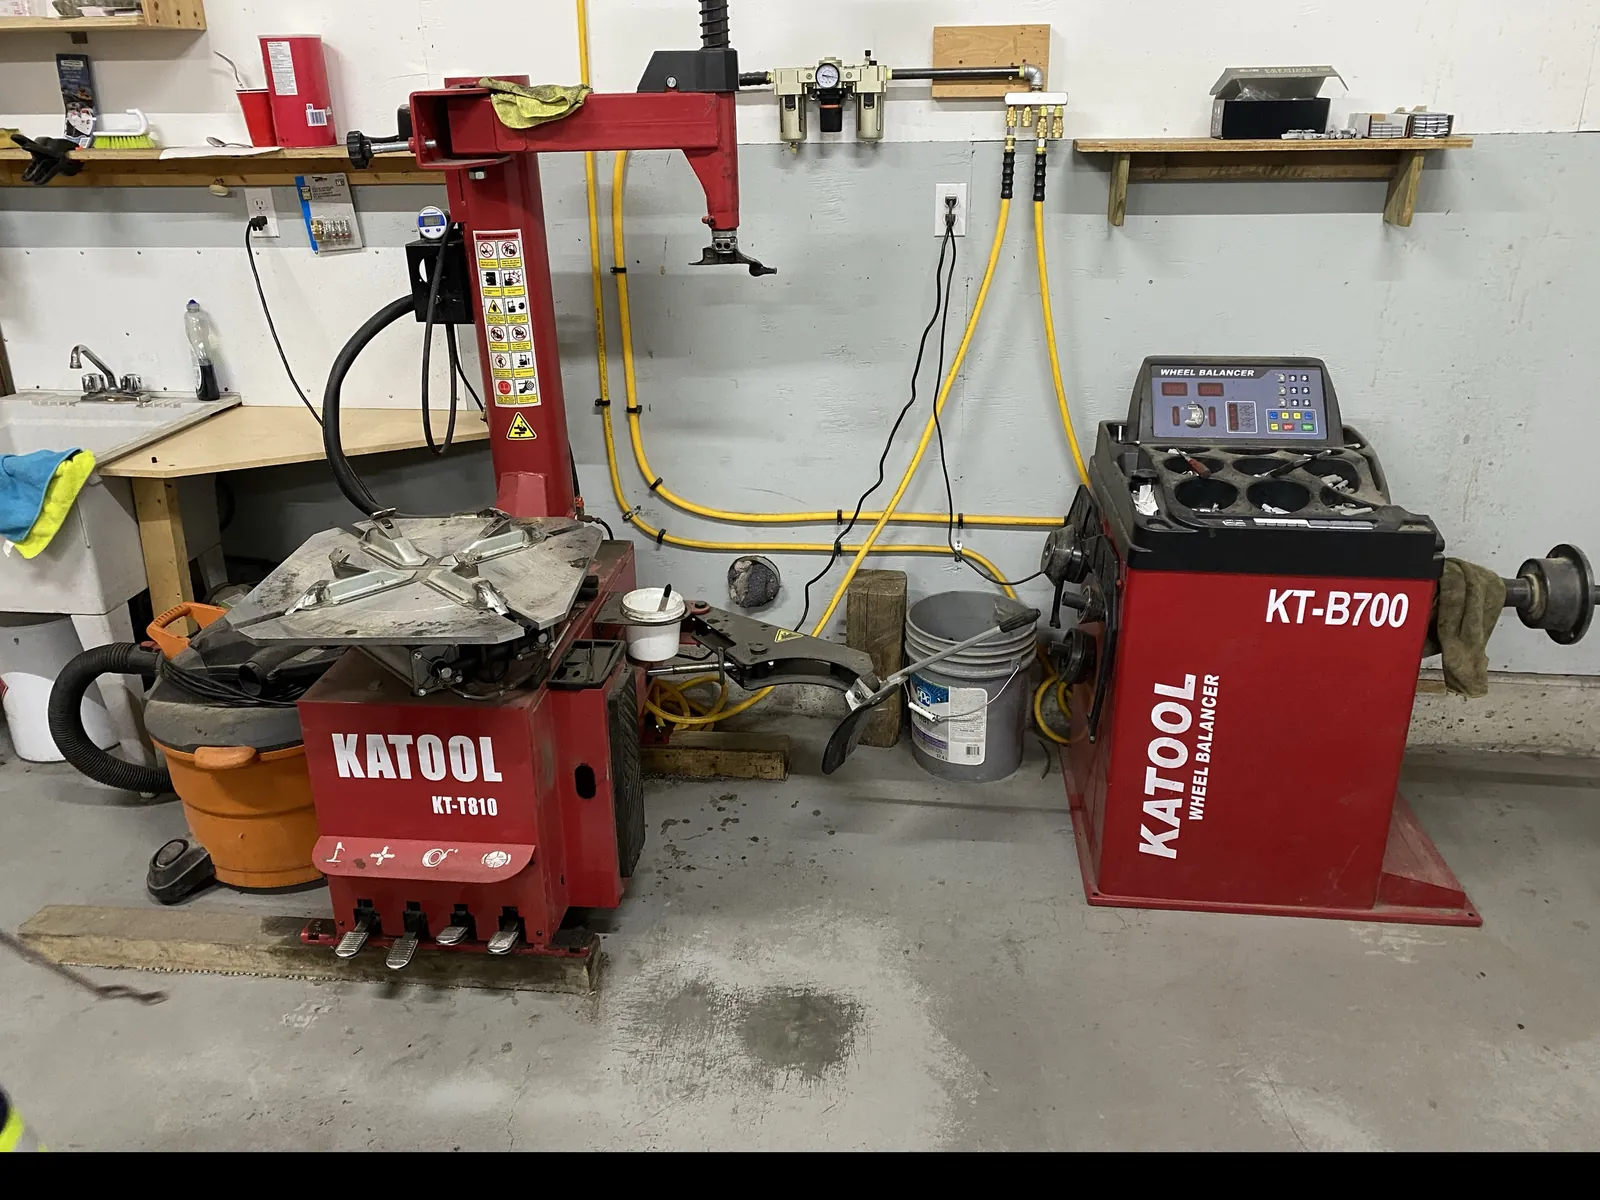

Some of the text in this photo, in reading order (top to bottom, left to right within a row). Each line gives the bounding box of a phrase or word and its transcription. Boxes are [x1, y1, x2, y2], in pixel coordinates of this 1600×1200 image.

[1160, 368, 1255, 377] WHEEL BALANCER
[1265, 588, 1409, 628] KT-B700
[331, 733, 503, 783] KATOOL
[1138, 673, 1197, 860] KATOOL
[1188, 674, 1220, 821] WHEEL BALANCER
[431, 795, 498, 816] KT-T810
